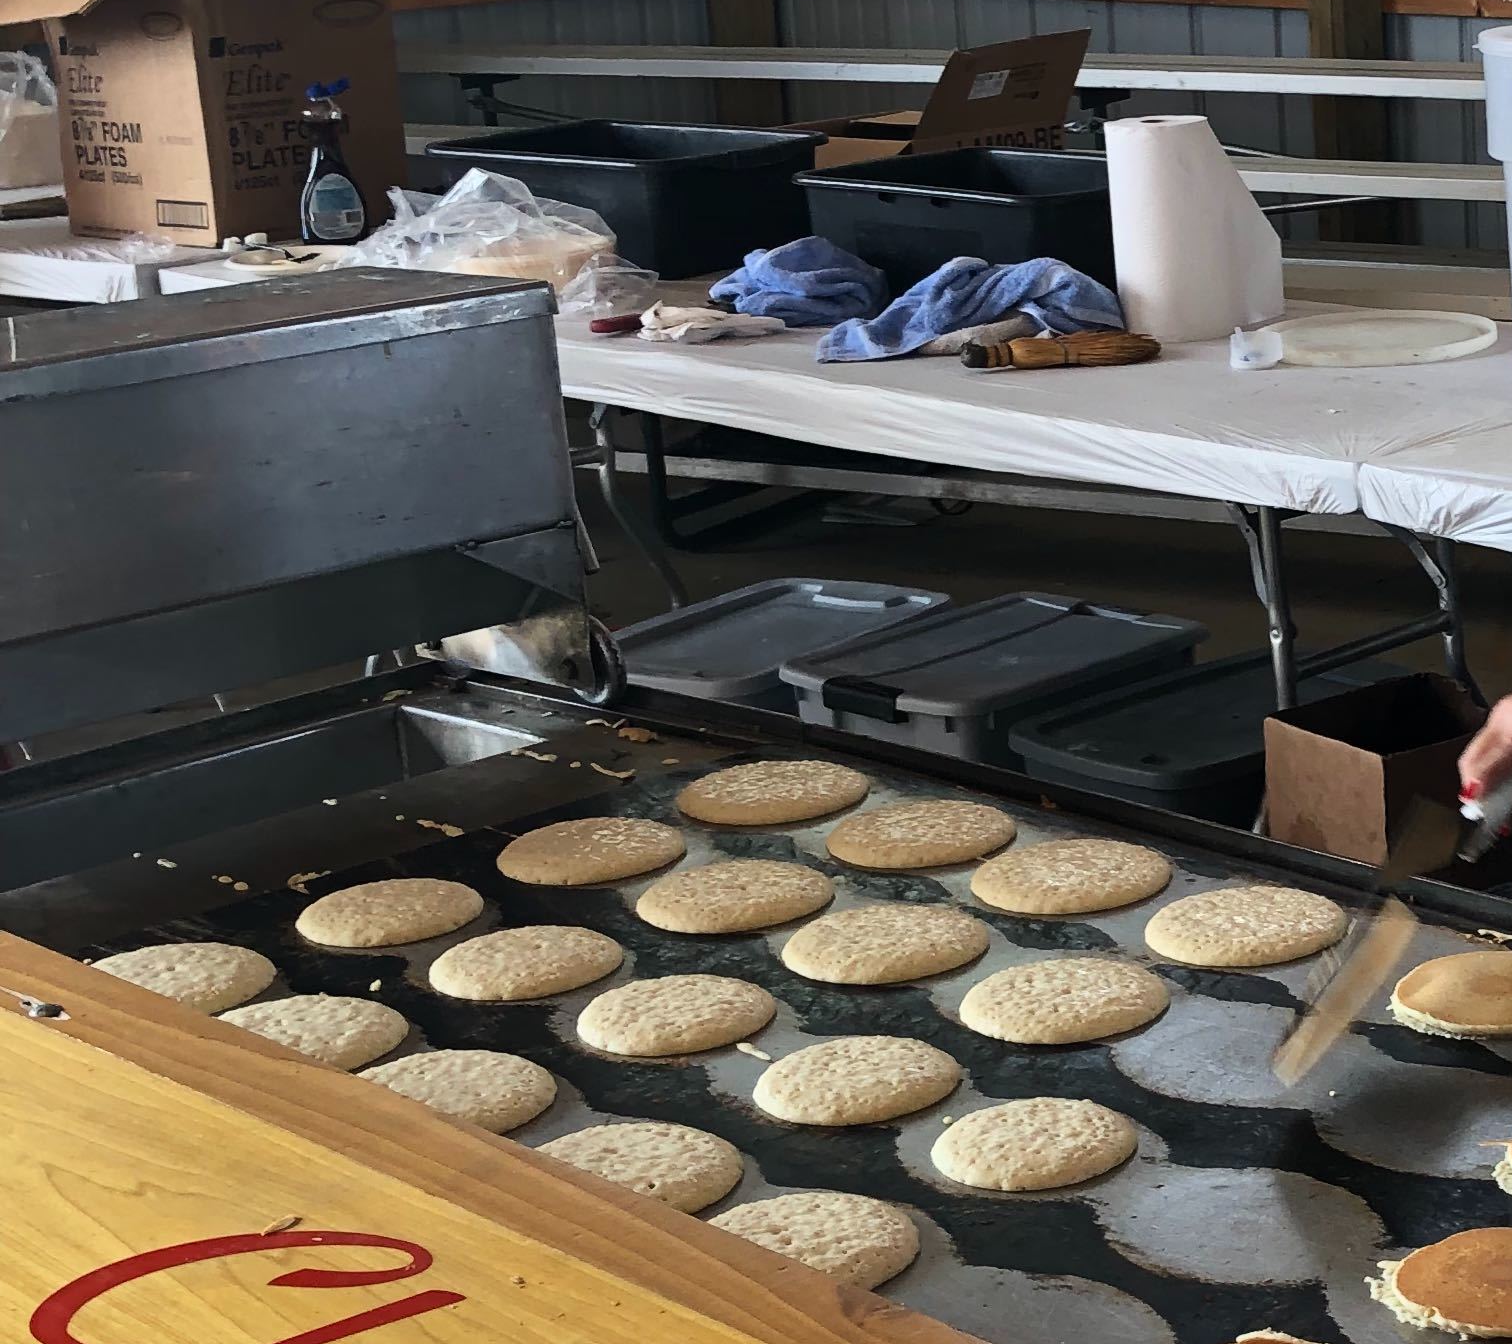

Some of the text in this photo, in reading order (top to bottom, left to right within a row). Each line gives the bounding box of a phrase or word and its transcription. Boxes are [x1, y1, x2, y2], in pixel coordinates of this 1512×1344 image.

[101, 121, 143, 143] FOAM
[75, 144, 127, 167] PLATES
[232, 145, 309, 170] PLATE
